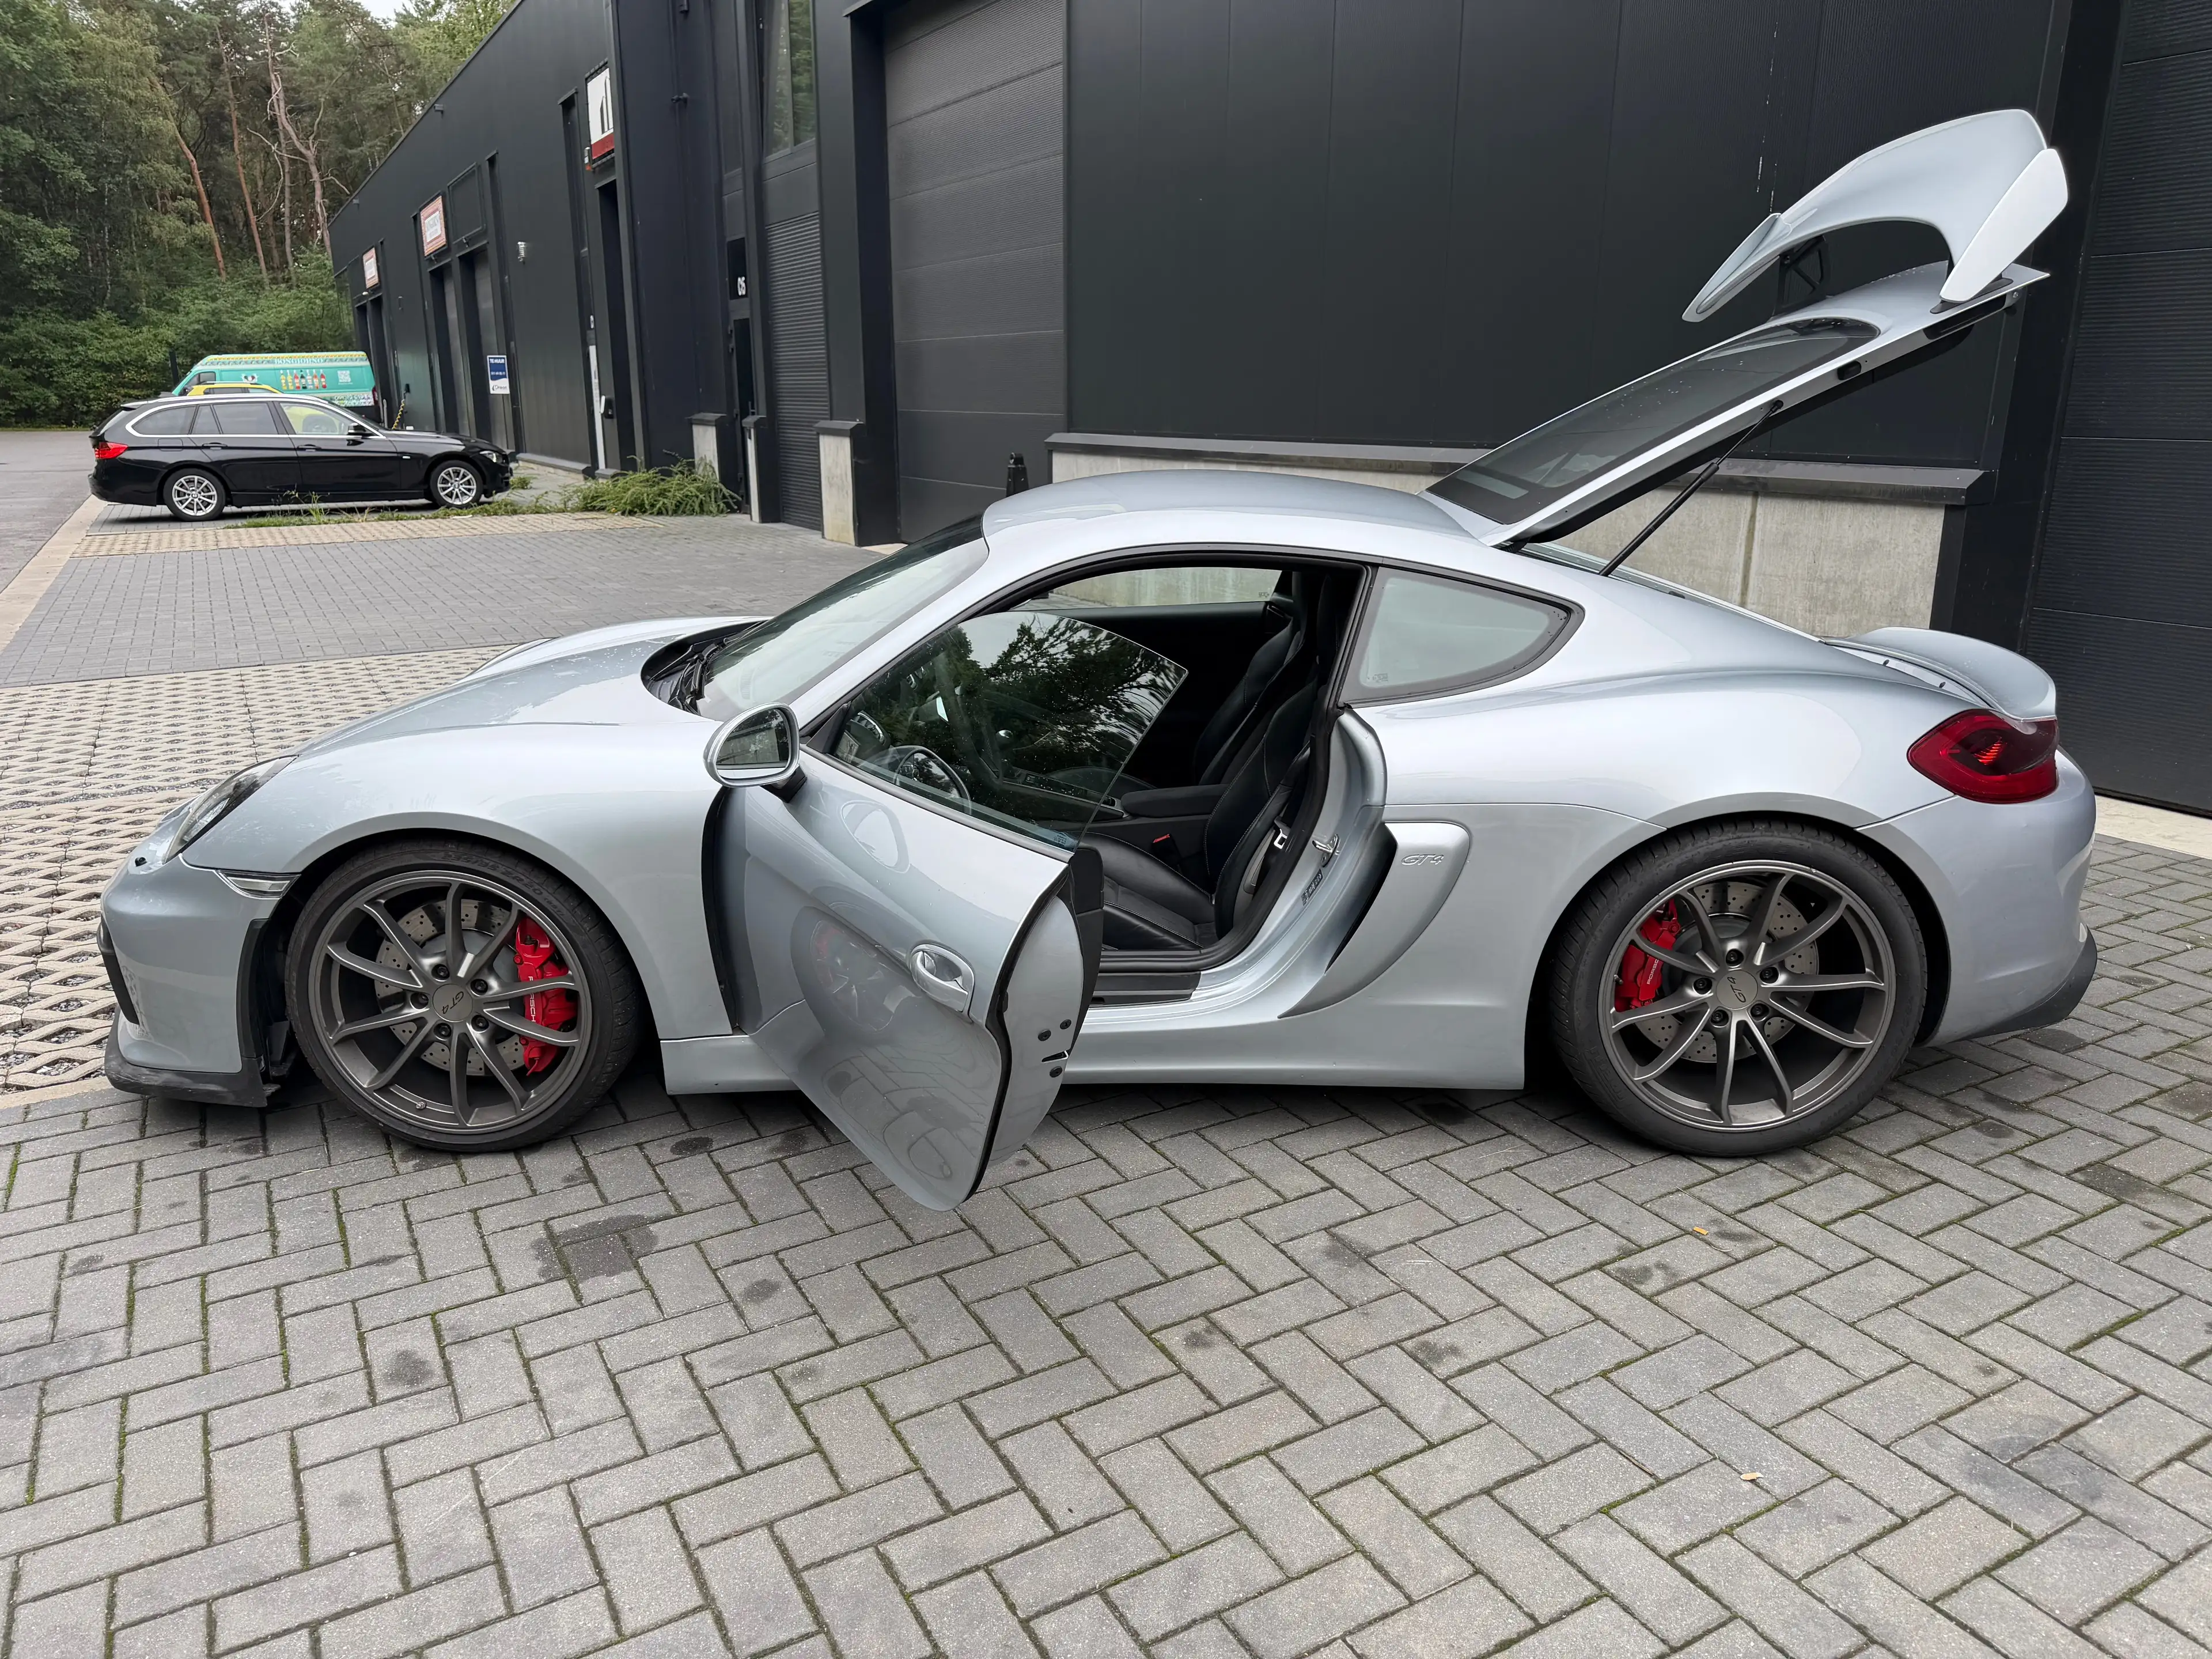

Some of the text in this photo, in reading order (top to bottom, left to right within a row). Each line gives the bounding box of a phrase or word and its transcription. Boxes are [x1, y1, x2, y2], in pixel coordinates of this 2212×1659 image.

[1401, 854, 1444, 866] GT4
[1646, 959, 1659, 985] PORSC
[441, 991, 464, 1014] GT4
[528, 976, 536, 1022] PRSCH
[1726, 976, 1747, 1003] GT4
